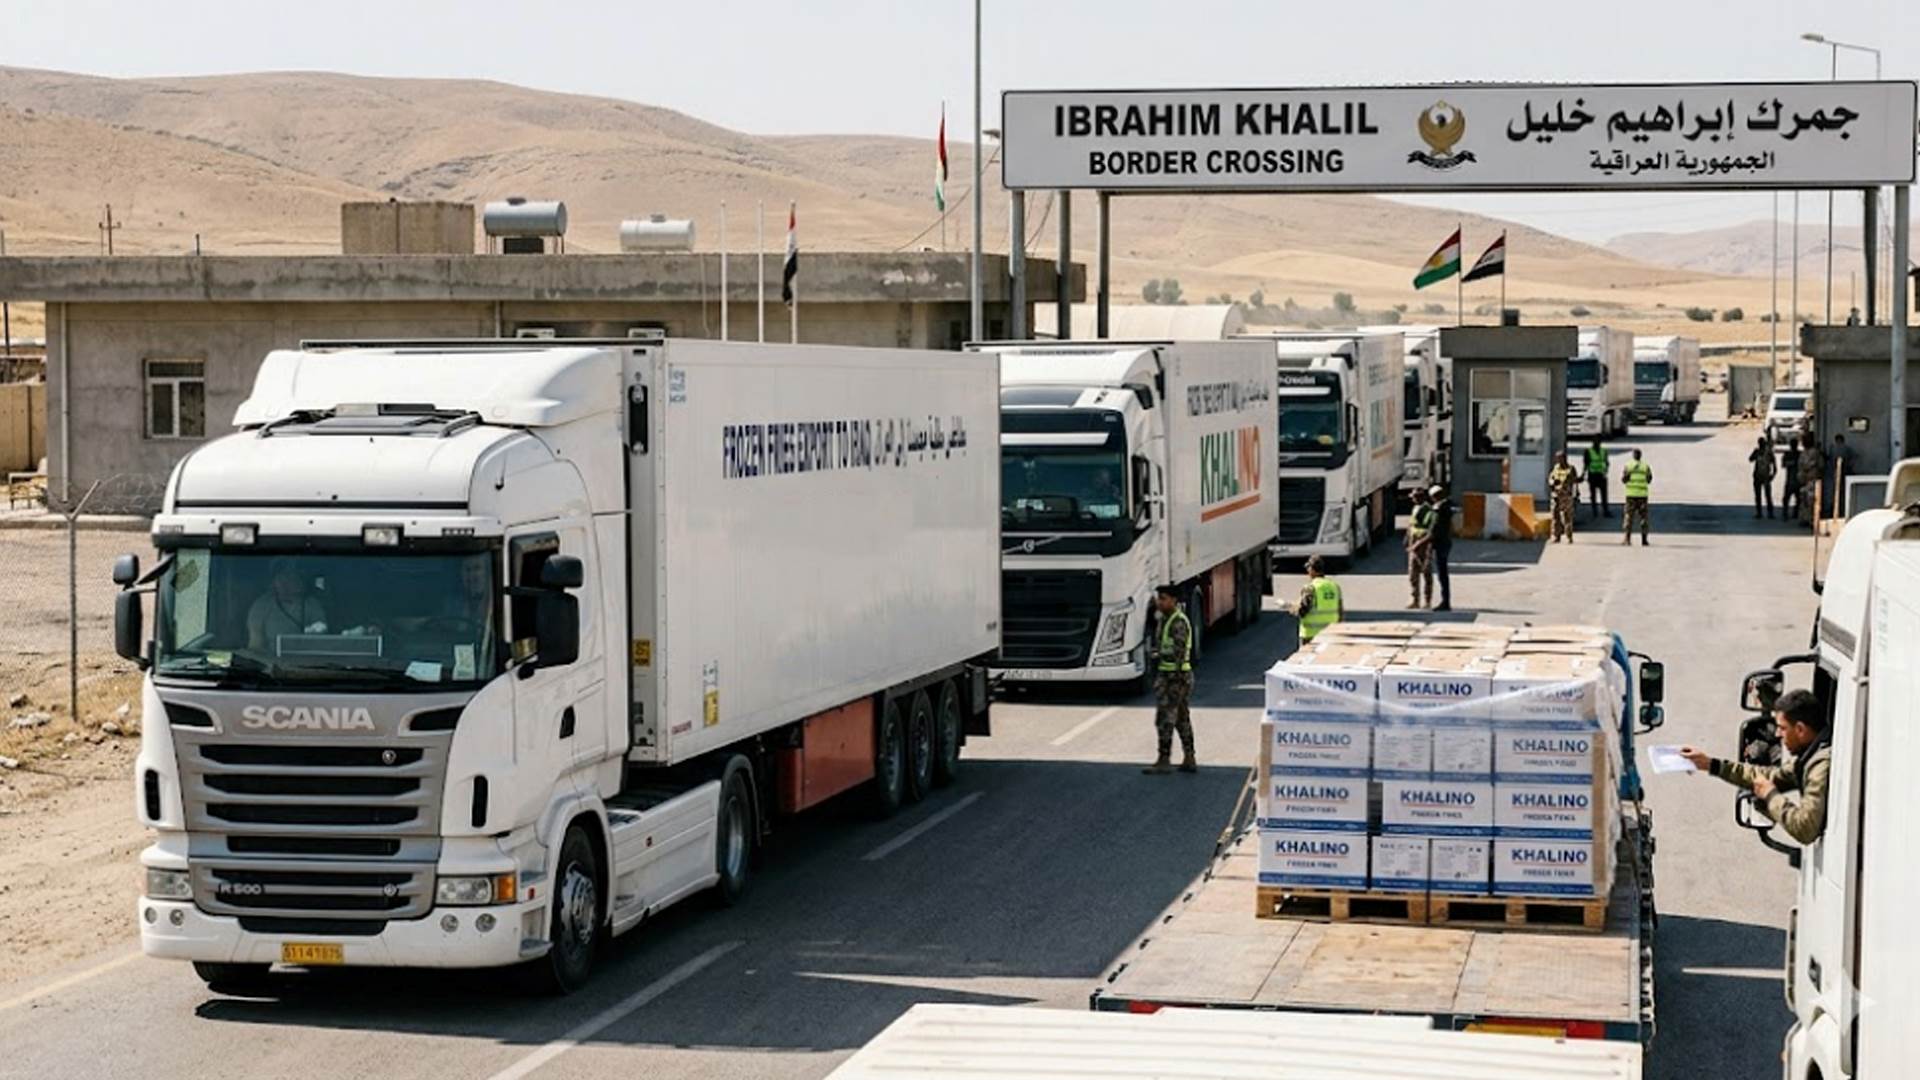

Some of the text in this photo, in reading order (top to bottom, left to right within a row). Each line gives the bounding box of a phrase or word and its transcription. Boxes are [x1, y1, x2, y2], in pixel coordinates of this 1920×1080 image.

[1055, 102, 1379, 136] IBRAHIM KHALIL
[1506, 97, 1860, 142] جمرك إبراهيم خليل
[1089, 149, 1344, 175] BORDER CROSSING
[1590, 149, 1775, 175] الجمهورية العراقية
[723, 424, 765, 479] FROZEN
[836, 420, 849, 469] TO
[1201, 426, 1261, 506] KHALINO
[1398, 682, 1472, 696] KHALINO
[241, 705, 376, 730] SCANIA
[1277, 731, 1352, 745] KHALINO
[1512, 738, 1589, 753] KHALINO
[1275, 785, 1349, 799] KHALINO
[1400, 790, 1475, 805] KHALINO
[1512, 793, 1589, 808] KHALINO
[1275, 840, 1350, 855] KHALINO
[1511, 849, 1588, 863] KHALINO
